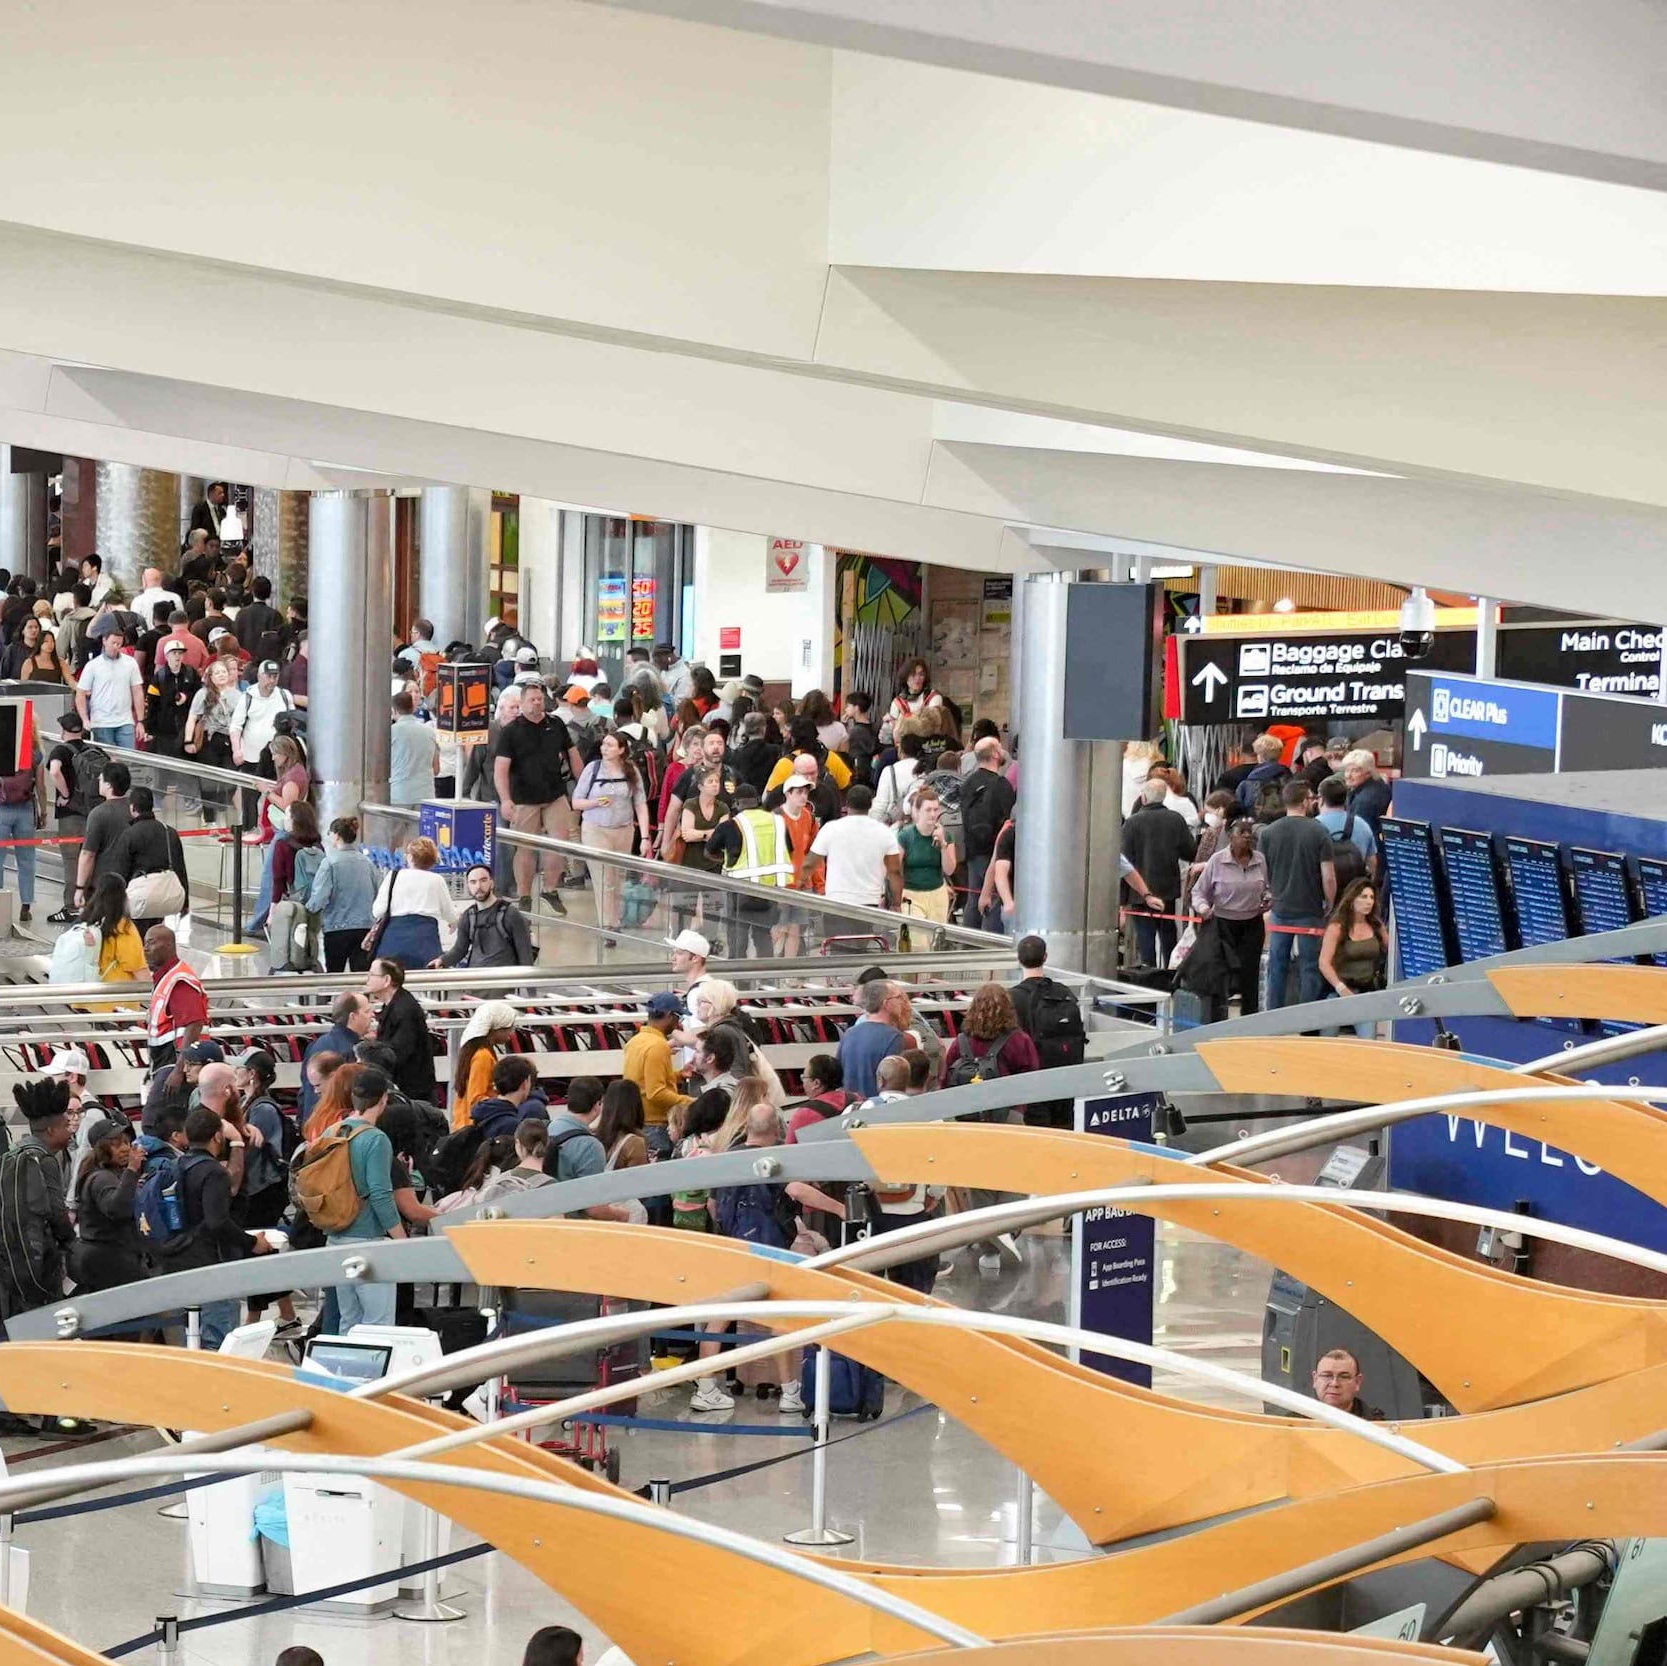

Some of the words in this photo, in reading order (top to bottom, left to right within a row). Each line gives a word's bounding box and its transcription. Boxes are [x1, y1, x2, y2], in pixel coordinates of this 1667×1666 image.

[1561, 632, 1609, 651] Main
[1272, 641, 1365, 664] Baggage
[1620, 652, 1660, 663] Control
[1272, 661, 1316, 675] Reclamo
[1319, 660, 1333, 673] de
[1336, 659, 1381, 675] Equipaje
[1576, 673, 1660, 691] Termina
[1270, 682, 1345, 704] Ground
[1350, 681, 1404, 701] Trans
[1270, 704, 1328, 716] Transporte
[1331, 702, 1377, 714] Terrestre
[1450, 697, 1485, 721] CLEAR
[1487, 701, 1508, 725] Plus
[1447, 751, 1483, 777] Priority
[1102, 1106, 1140, 1124] DELTA
[1085, 1206, 1104, 1222] APP
[1090, 1241, 1103, 1251] FOR
[1103, 1238, 1127, 1249] ACCESS:
[1102, 1263, 1111, 1272] App
[1112, 1260, 1133, 1271] Boarding
[1134, 1258, 1145, 1266] Pass
[1102, 1276, 1131, 1287] Identification
[1132, 1273, 1147, 1283] Ready
